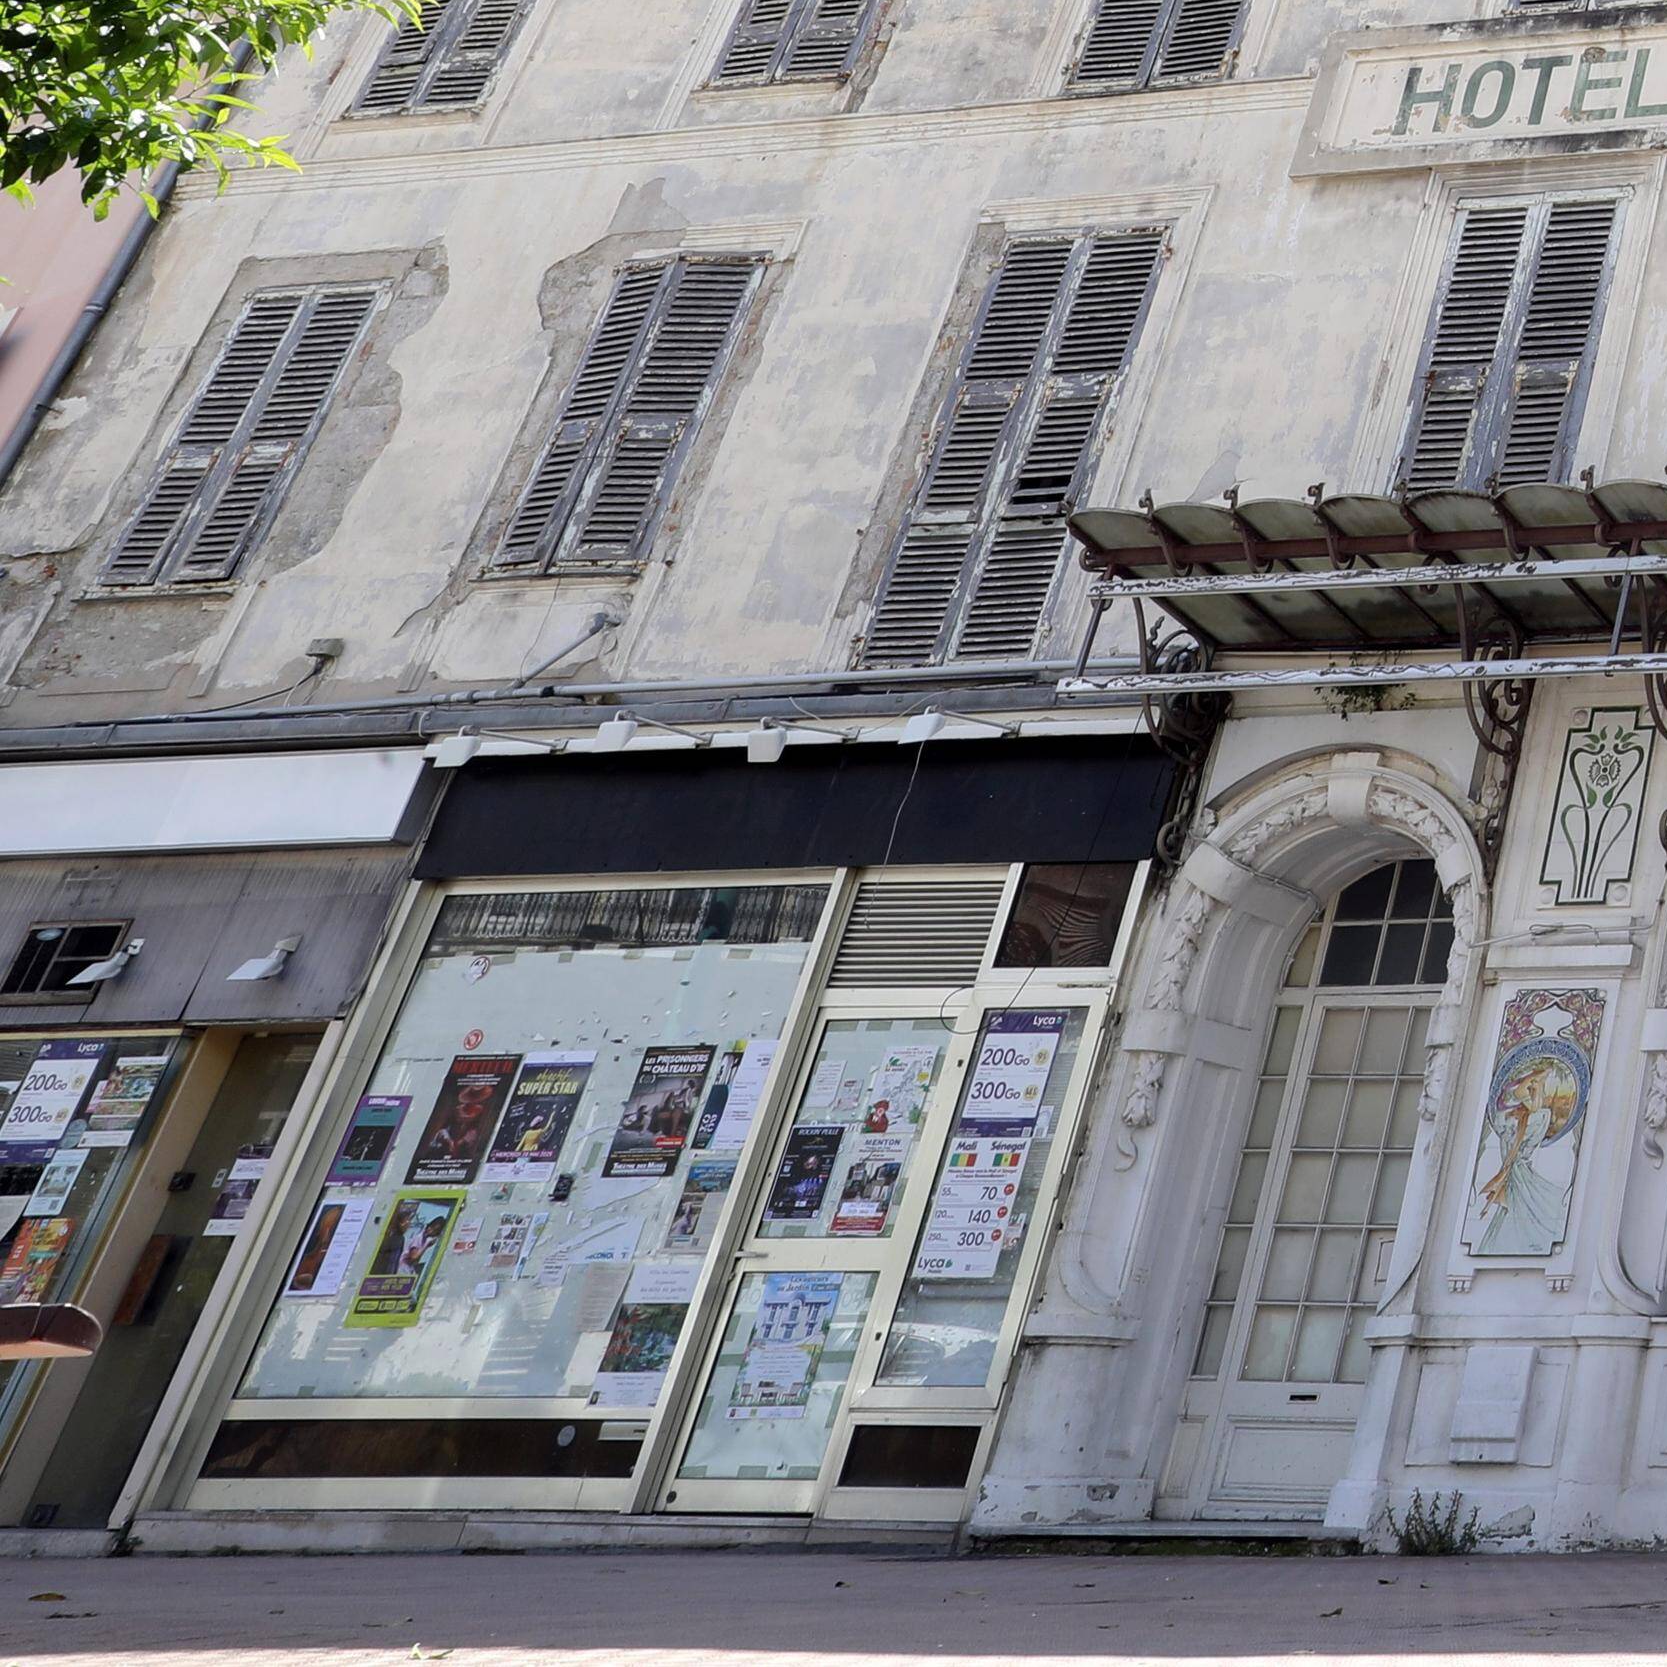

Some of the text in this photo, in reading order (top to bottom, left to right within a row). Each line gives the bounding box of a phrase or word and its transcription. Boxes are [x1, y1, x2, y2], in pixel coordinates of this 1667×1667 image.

[1033, 1015, 1056, 1027] Lyca
[77, 1043, 98, 1054] Lyca
[645, 1053, 709, 1065] LES PRISONNIERS
[980, 1048, 1030, 1066] 200Go
[652, 1063, 690, 1074] CHÂTEAU
[24, 1074, 68, 1091] 200Go
[518, 1081, 579, 1096] SUPER STAR
[970, 1081, 1021, 1100] 300Go
[8, 1105, 52, 1124] 300Go
[864, 1138, 902, 1146] MENTON
[956, 1140, 1027, 1152] Mali Sénégal
[980, 1186, 998, 1200] 70
[967, 1209, 991, 1224] 140
[957, 1232, 984, 1246] 300
[918, 1256, 946, 1271] Lyca
